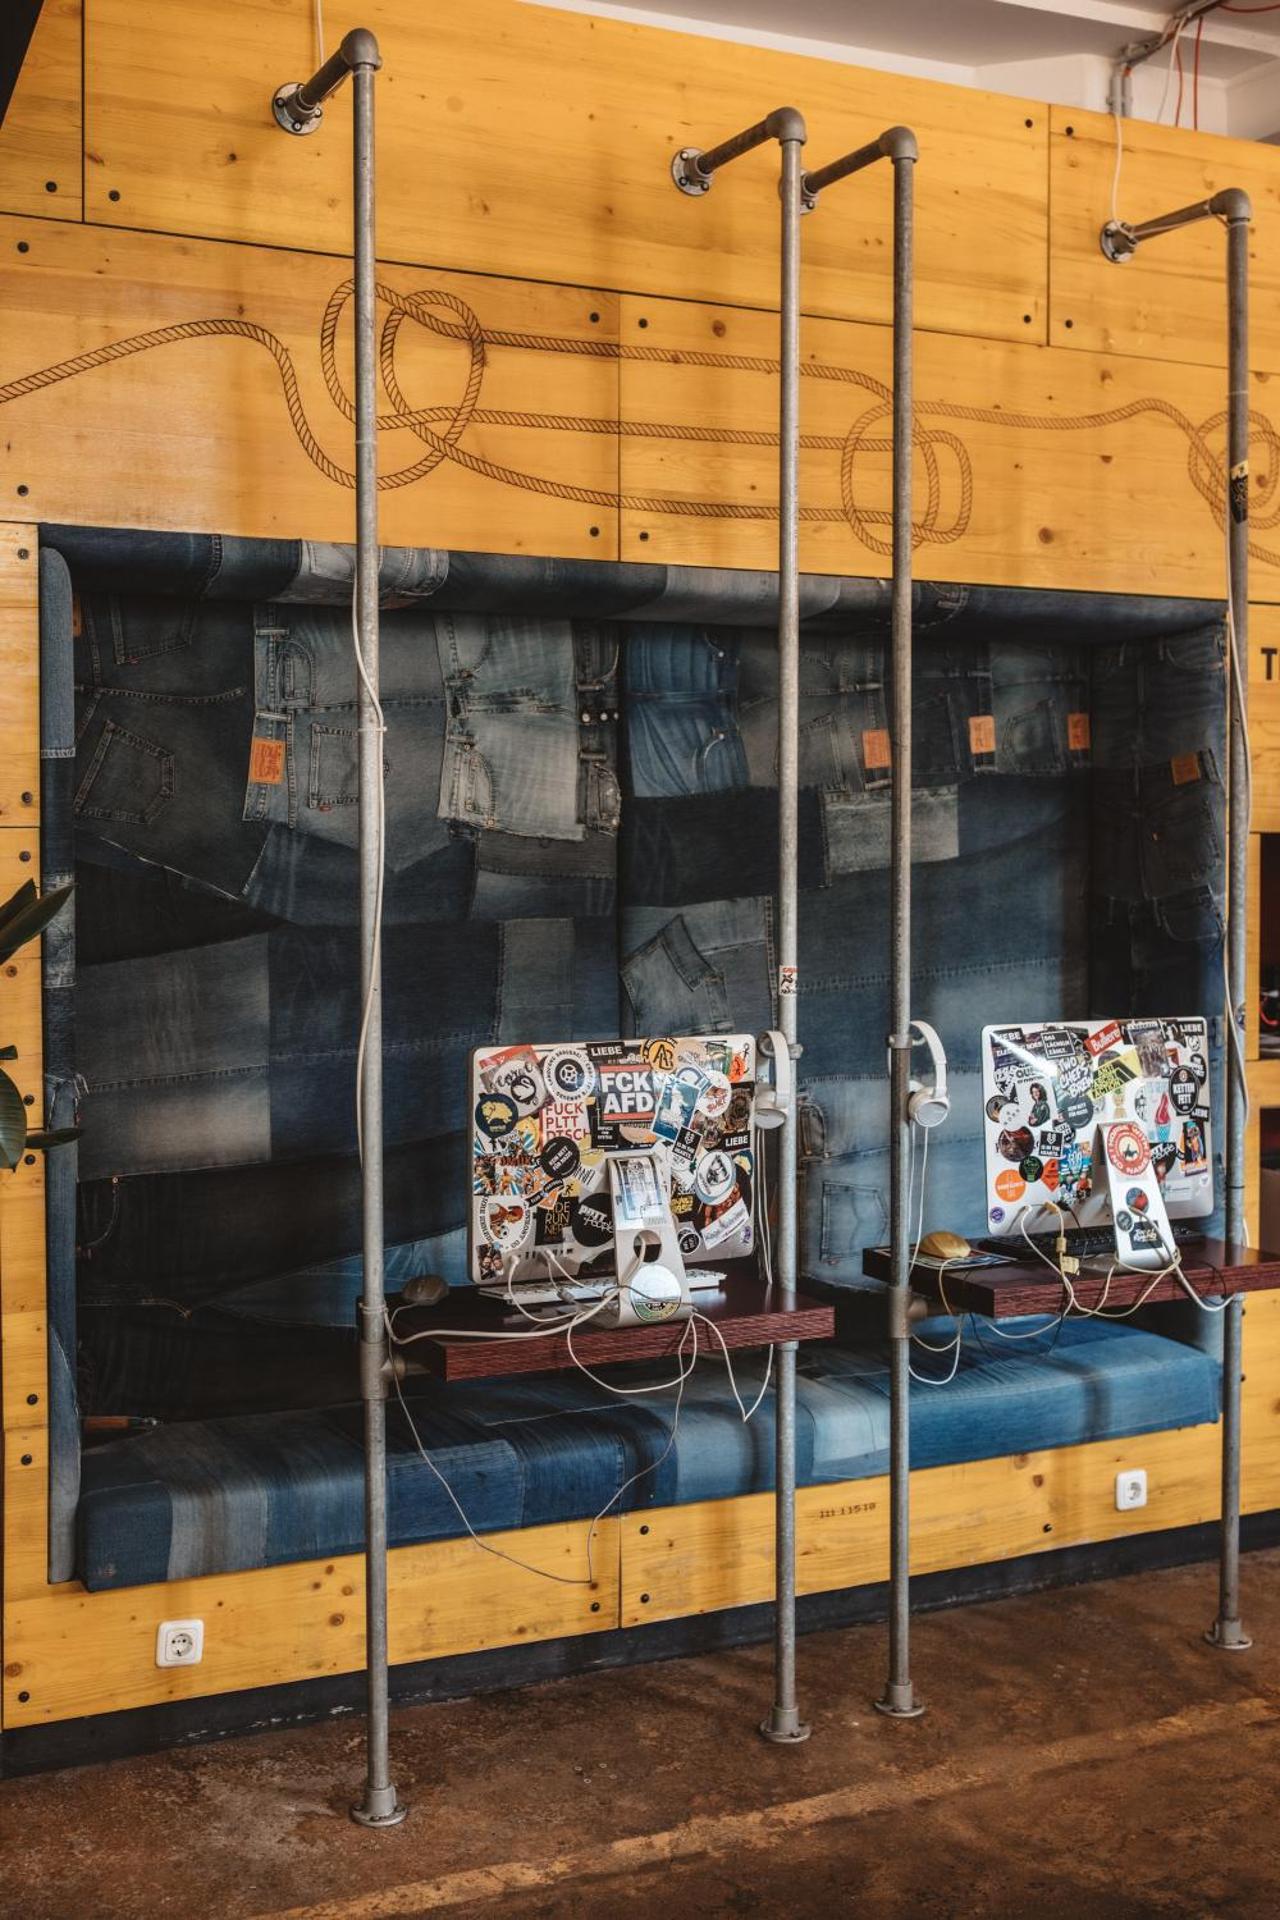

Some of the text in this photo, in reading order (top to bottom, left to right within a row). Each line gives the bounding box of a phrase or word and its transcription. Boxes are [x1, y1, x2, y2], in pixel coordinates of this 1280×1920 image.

[1261, 648, 1280, 680] T
[591, 1045, 622, 1056] LIEBE
[600, 1072, 651, 1092] FCK
[545, 1102, 584, 1115] FUCK
[604, 1093, 654, 1113] AFD
[546, 1115, 579, 1129] PLTT
[725, 1135, 748, 1147] LIEBE
[545, 1212, 570, 1224] RUN
